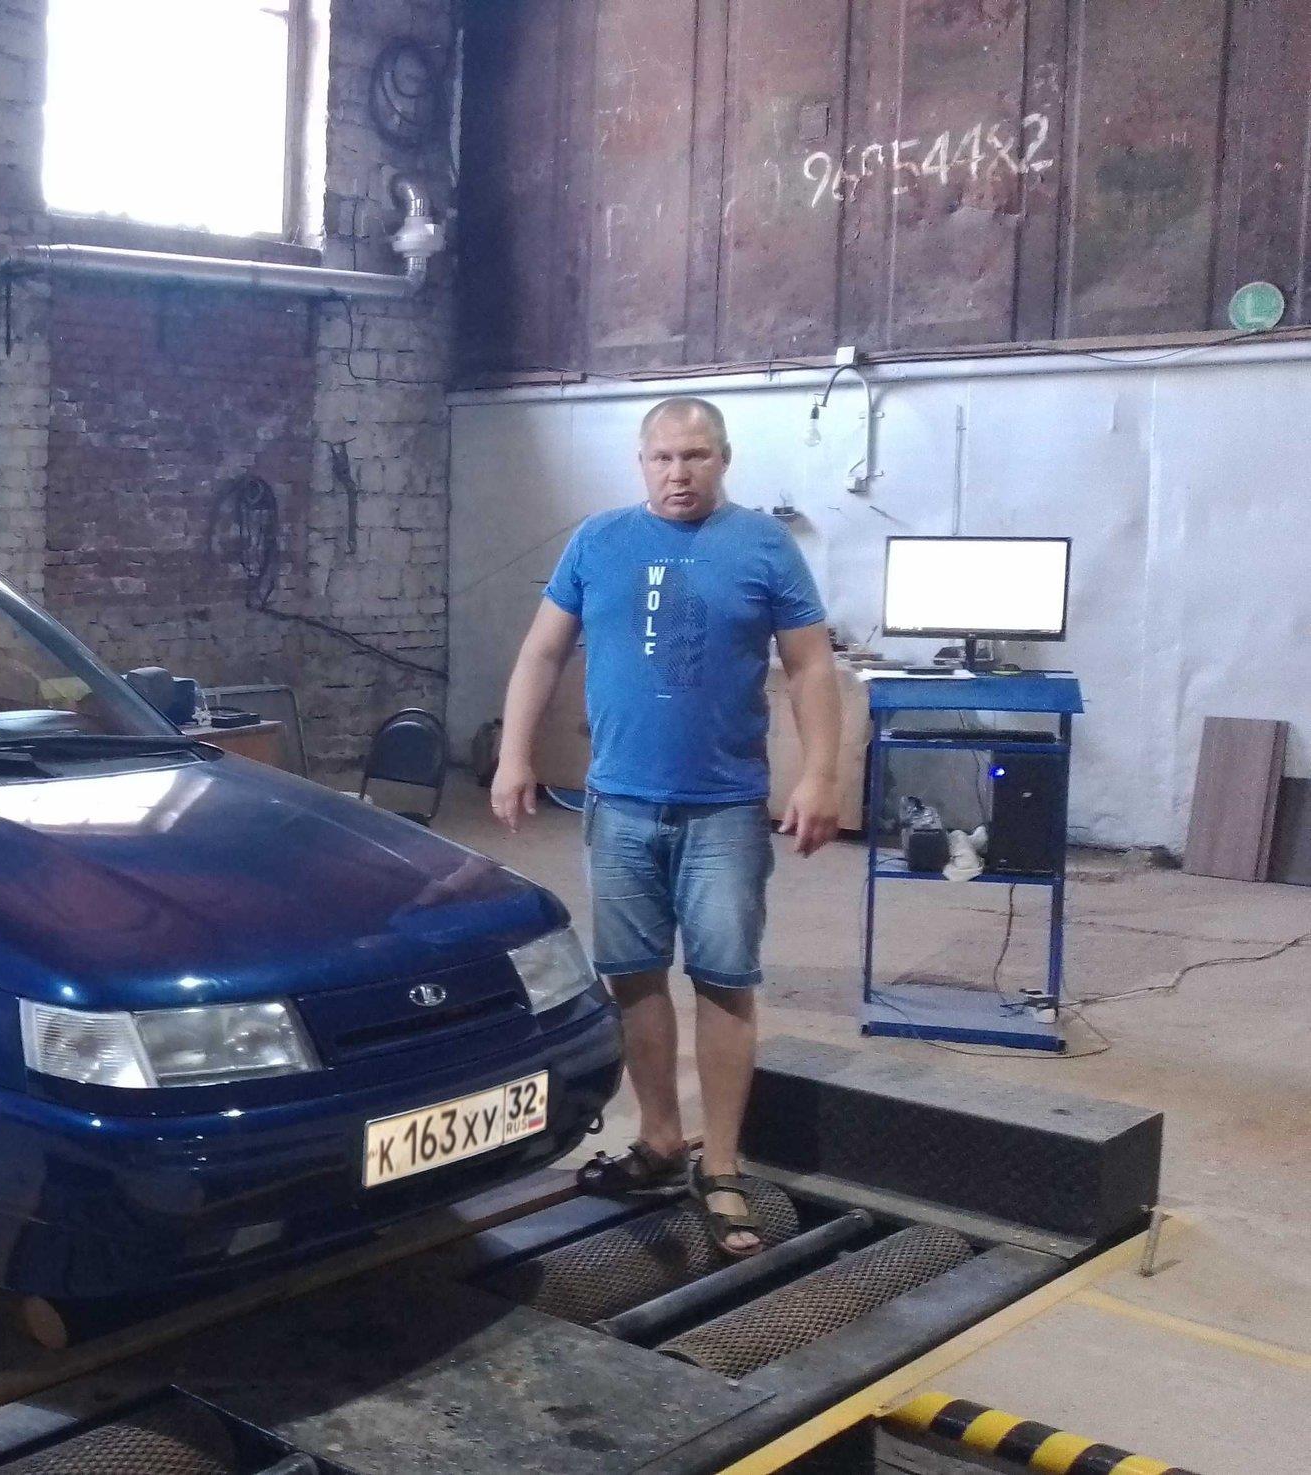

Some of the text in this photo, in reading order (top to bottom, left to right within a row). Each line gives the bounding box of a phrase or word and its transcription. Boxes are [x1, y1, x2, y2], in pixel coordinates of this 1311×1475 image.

[379, 1081, 538, 1176] К163ХУ 32
[506, 1117, 528, 1134] RUS
